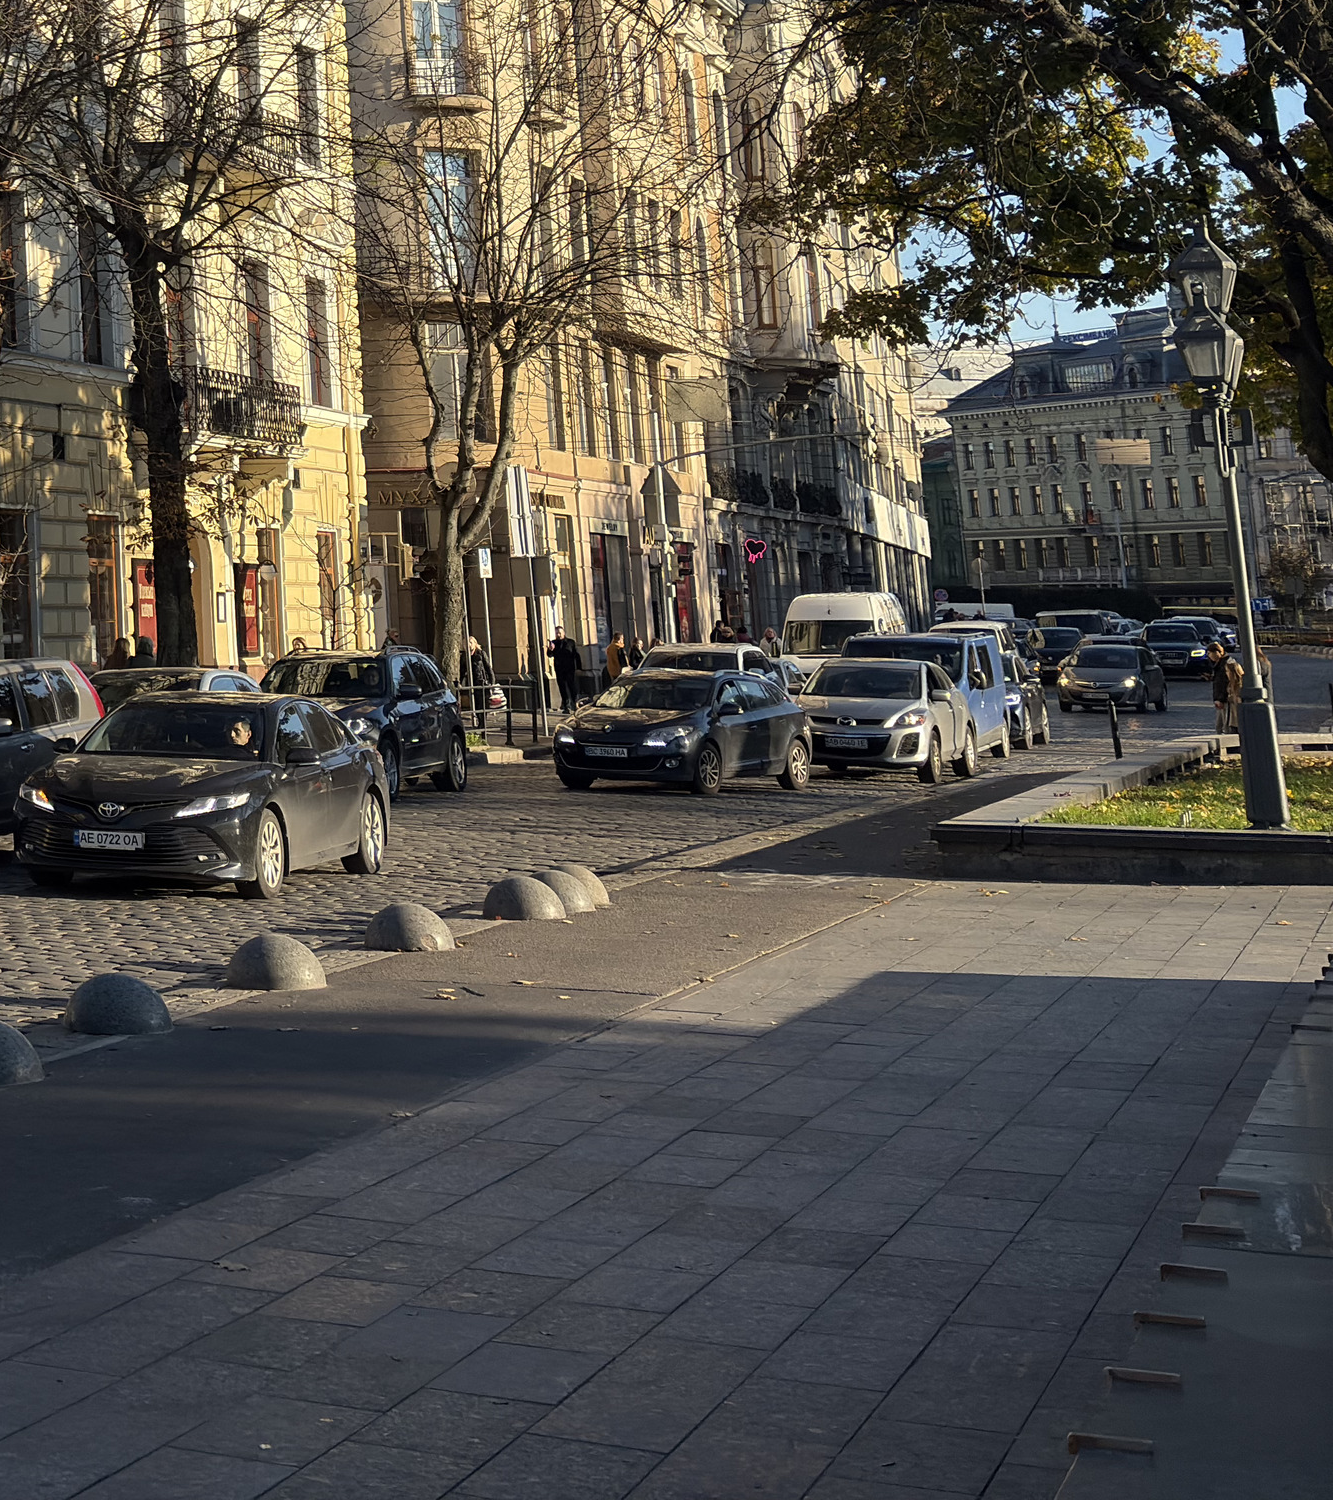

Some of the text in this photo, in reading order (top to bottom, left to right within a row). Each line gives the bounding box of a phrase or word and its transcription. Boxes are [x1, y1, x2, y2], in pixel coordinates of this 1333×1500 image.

[80, 832, 139, 846] AE 0722 OA
